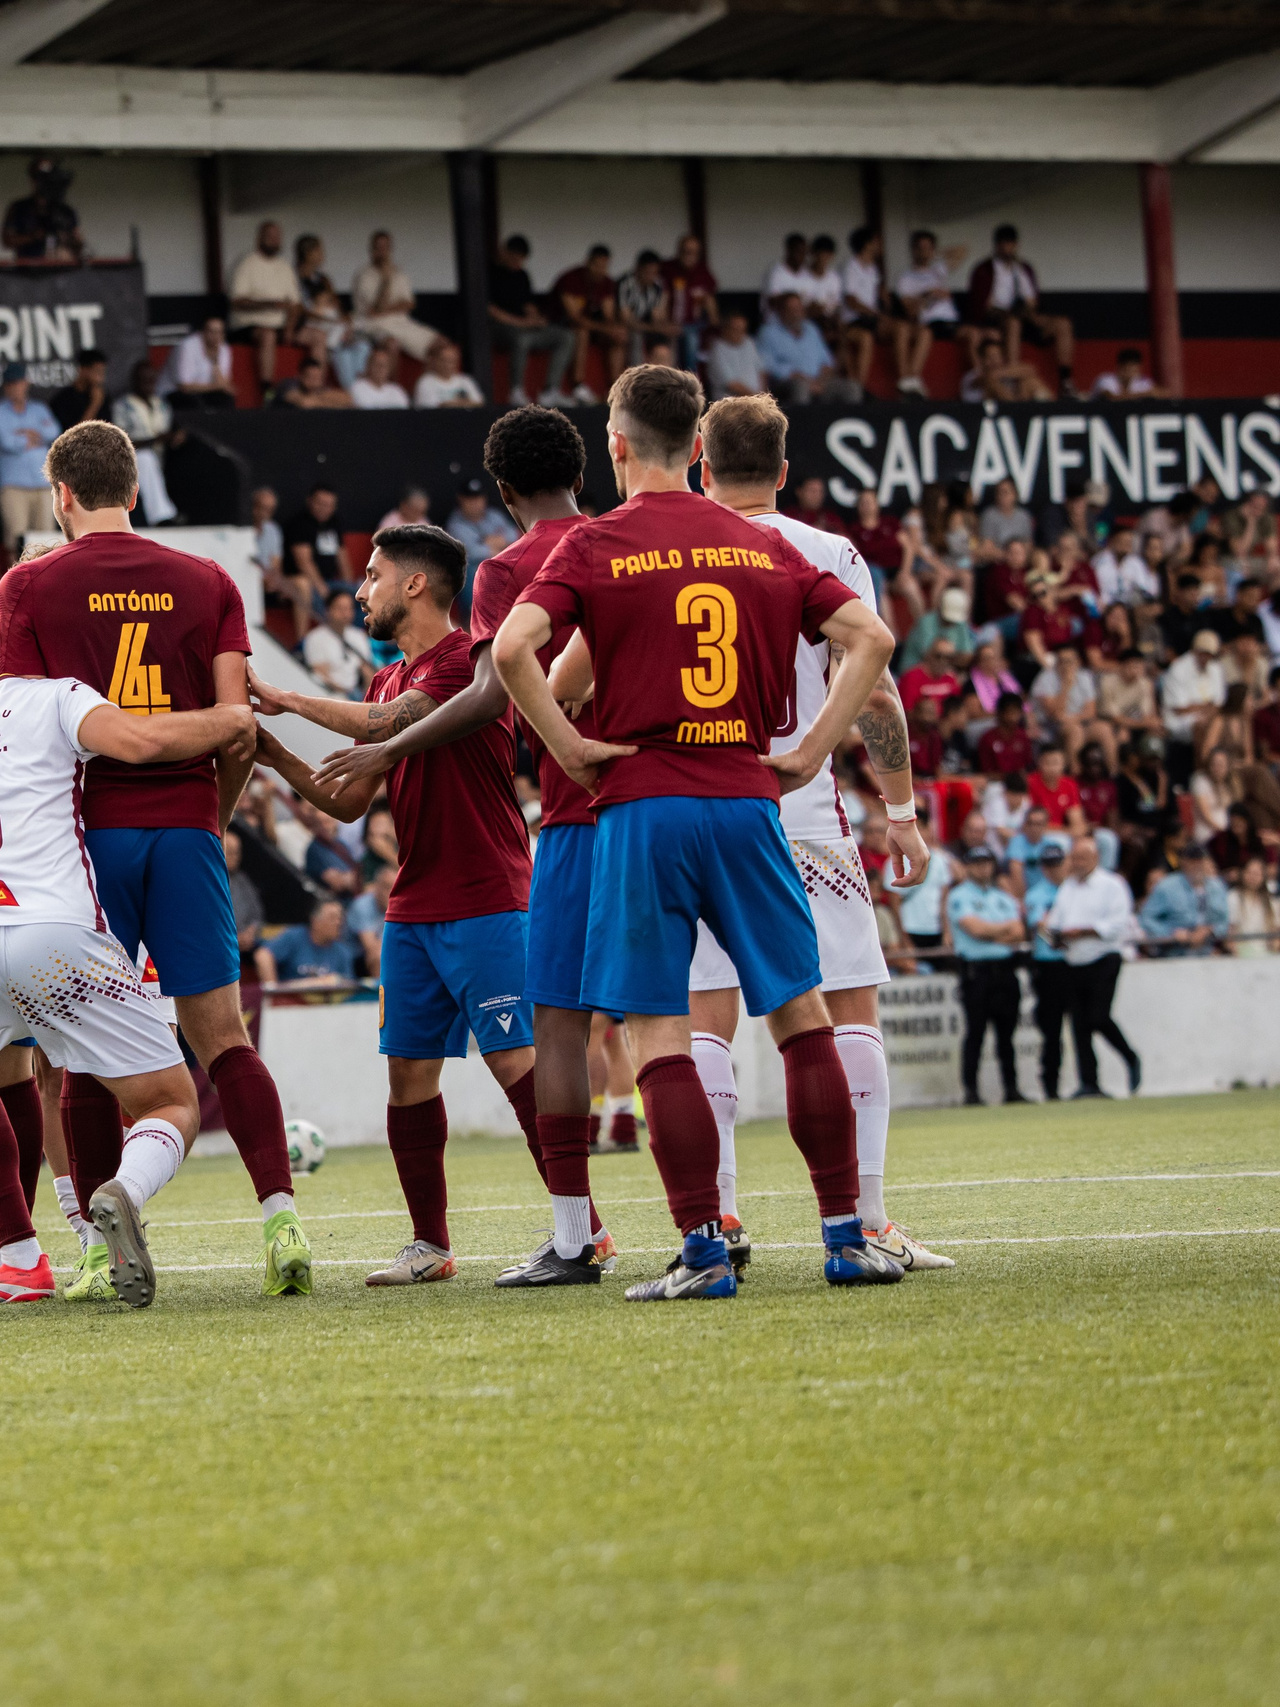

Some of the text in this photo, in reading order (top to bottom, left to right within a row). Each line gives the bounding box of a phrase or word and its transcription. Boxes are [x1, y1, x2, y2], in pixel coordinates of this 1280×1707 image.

[610, 547, 775, 579] PAULO FREITAS
[88, 589, 174, 612] ANTÓNIO
[675, 582, 739, 709] 3
[107, 622, 172, 717] 4
[676, 719, 747, 744] MARIA
